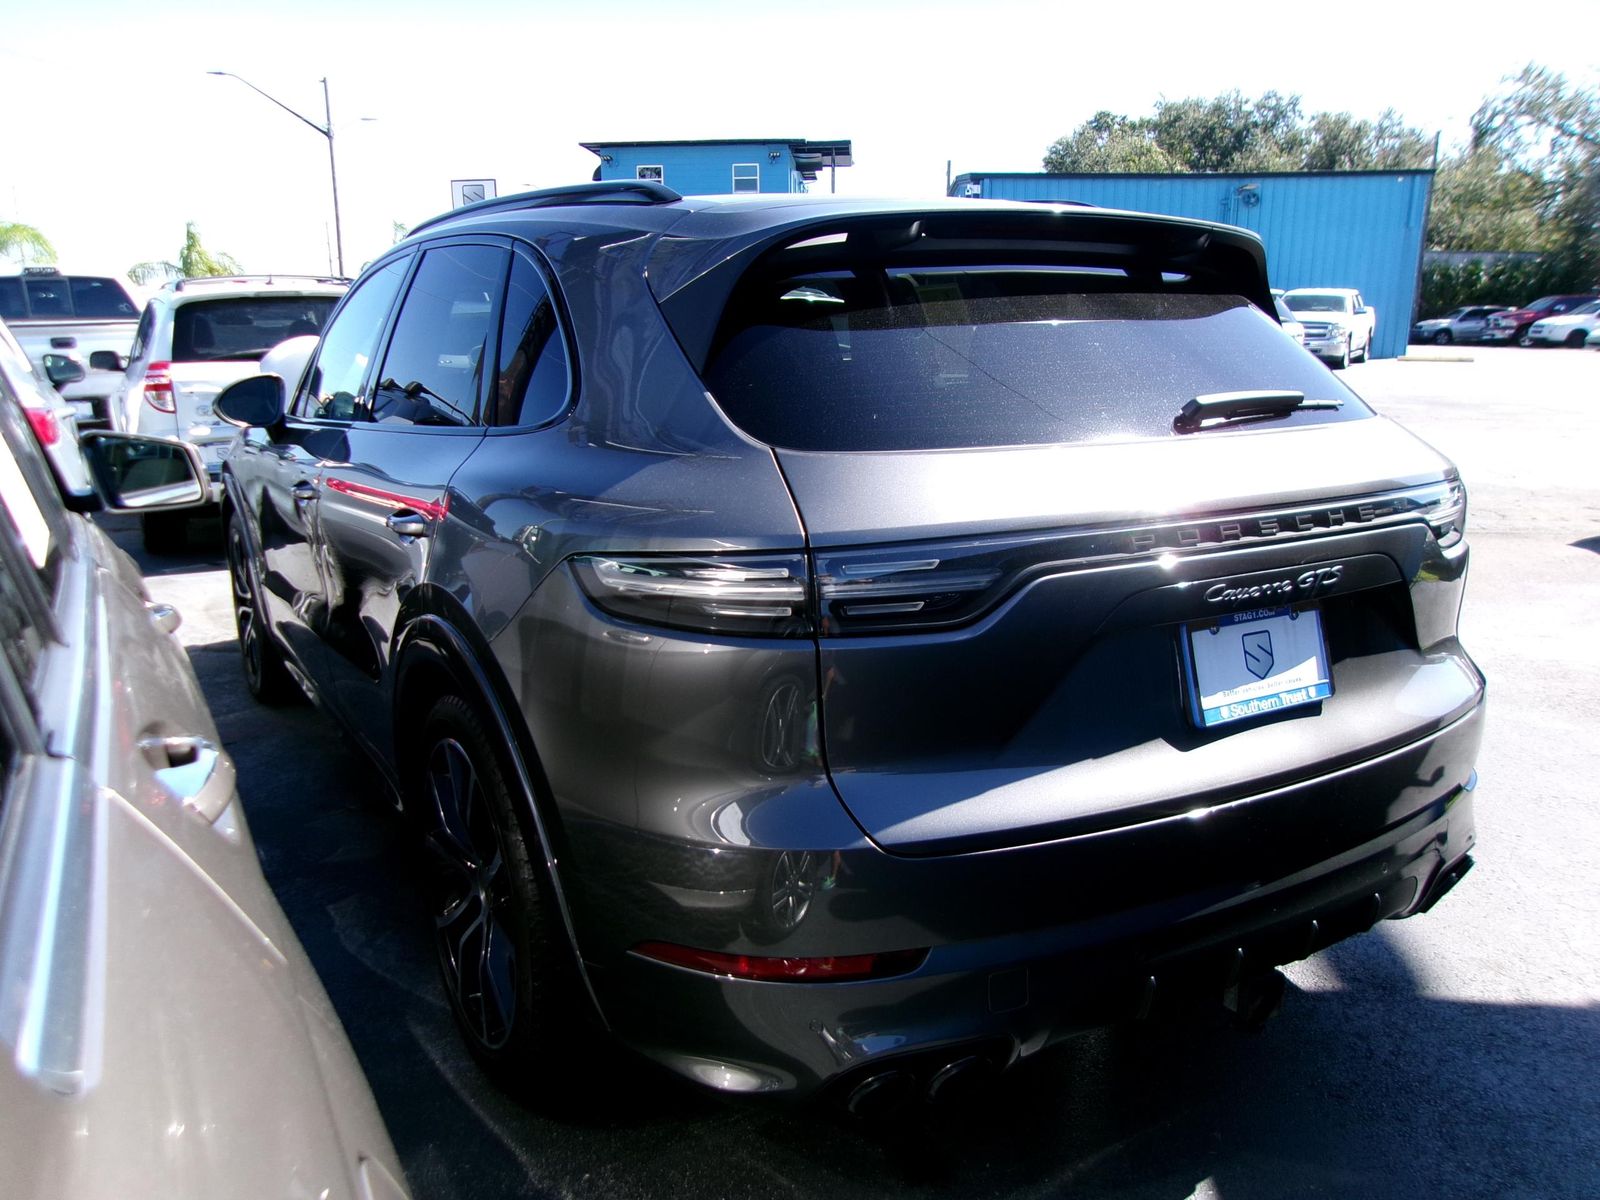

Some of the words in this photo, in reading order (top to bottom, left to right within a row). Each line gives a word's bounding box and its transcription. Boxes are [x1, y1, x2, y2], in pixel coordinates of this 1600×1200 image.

[1131, 505, 1377, 554] PORSCHE
[1204, 574, 1293, 607] Cayenne
[1297, 565, 1344, 598] GTS
[1230, 697, 1280, 716] Southern
[1279, 689, 1308, 706] Trust
